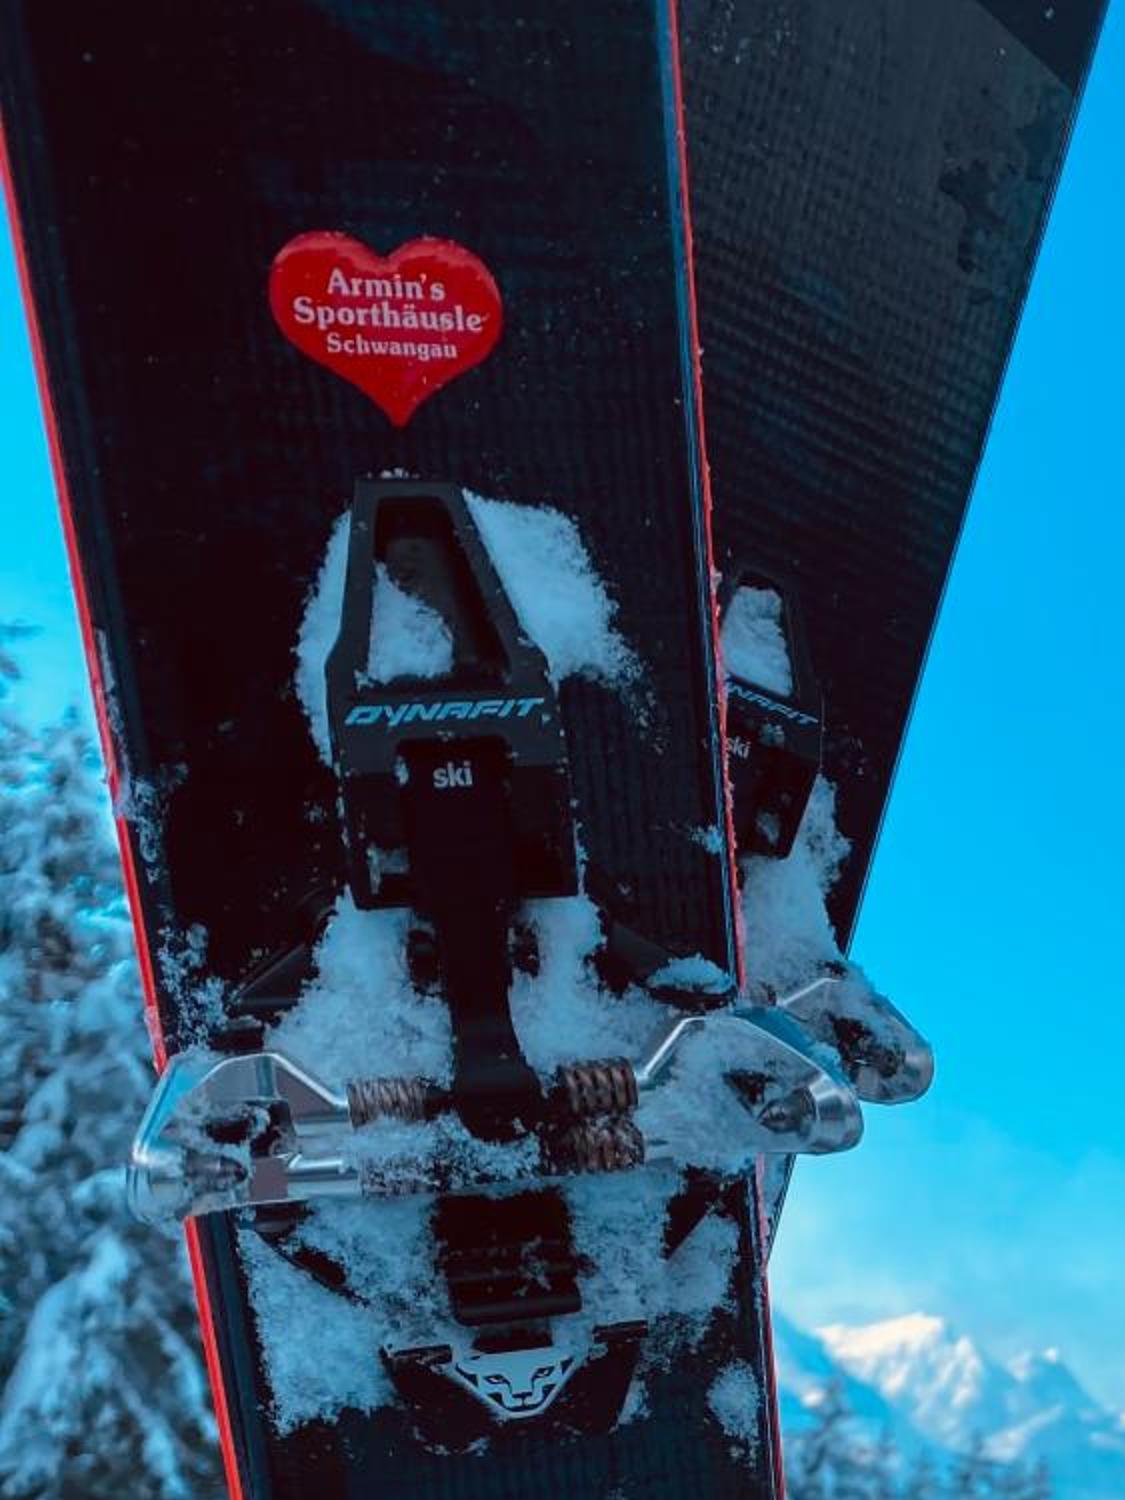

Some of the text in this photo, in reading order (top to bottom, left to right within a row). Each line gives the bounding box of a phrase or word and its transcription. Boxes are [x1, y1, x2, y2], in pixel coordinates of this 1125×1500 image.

[327, 267, 446, 301] Armin's
[293, 295, 483, 332] Sporthäusle
[327, 332, 458, 360] Schwangau
[345, 697, 545, 728] DYNAFIT
[433, 761, 473, 788] ski
